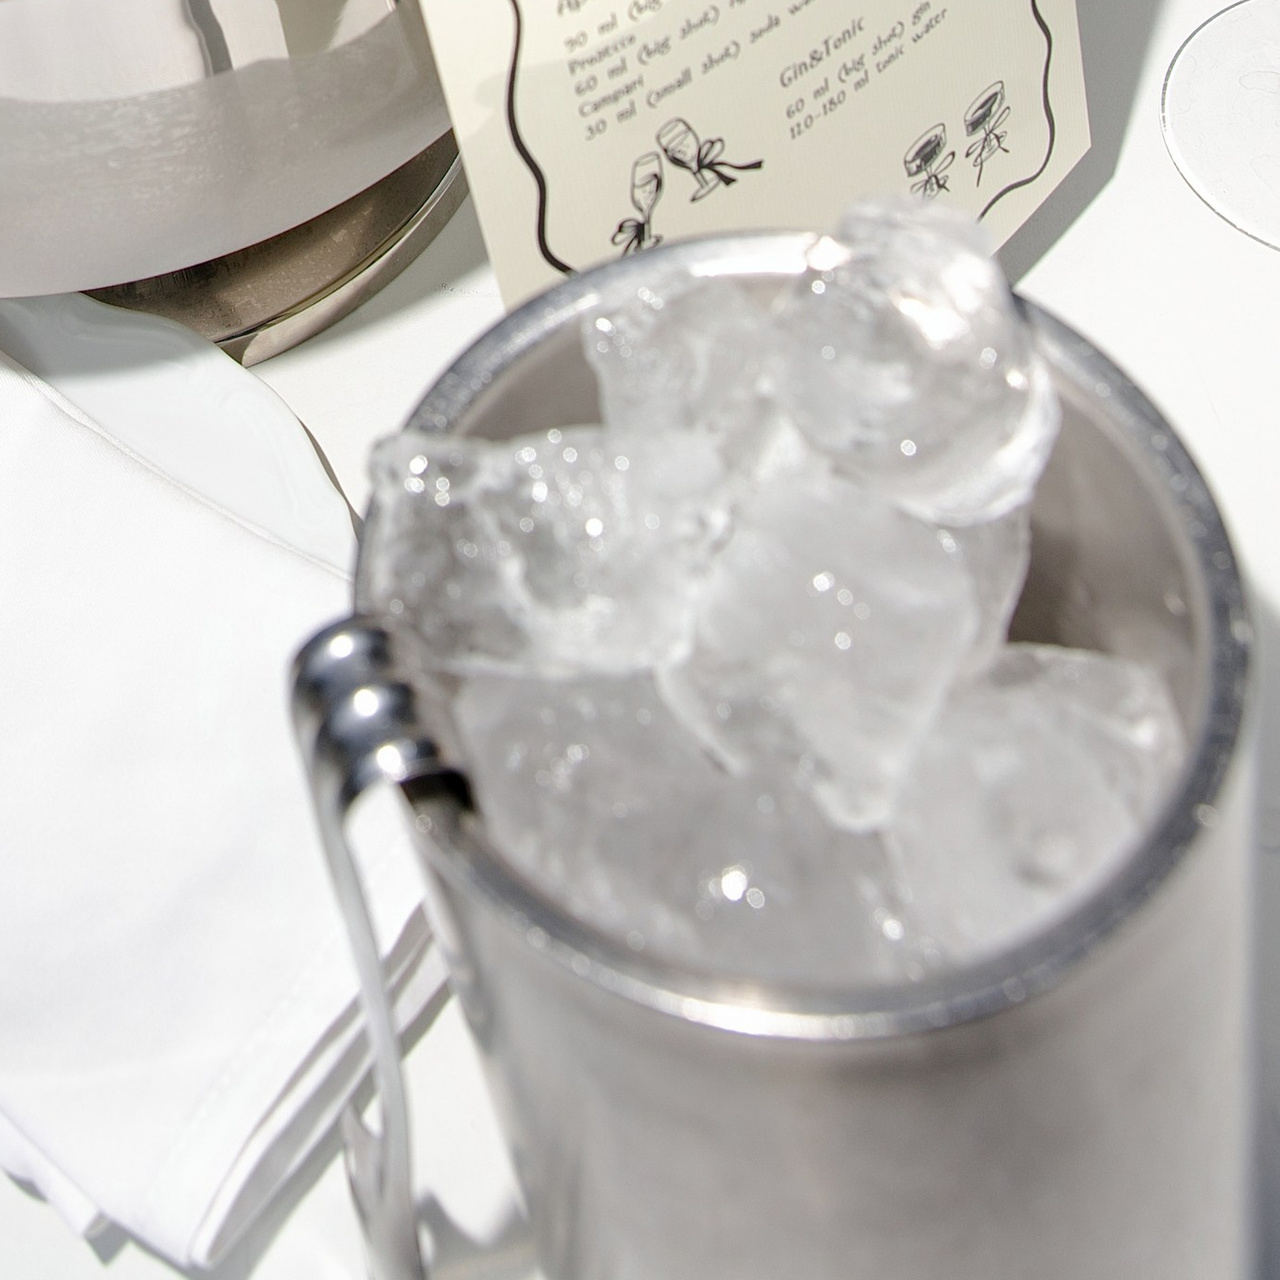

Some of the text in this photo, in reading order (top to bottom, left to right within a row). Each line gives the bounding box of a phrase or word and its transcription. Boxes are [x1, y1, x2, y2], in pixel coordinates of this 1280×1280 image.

[780, 19, 863, 87] Gin&Tonic
[876, 45, 904, 73] tonic
[912, 8, 947, 43] water
